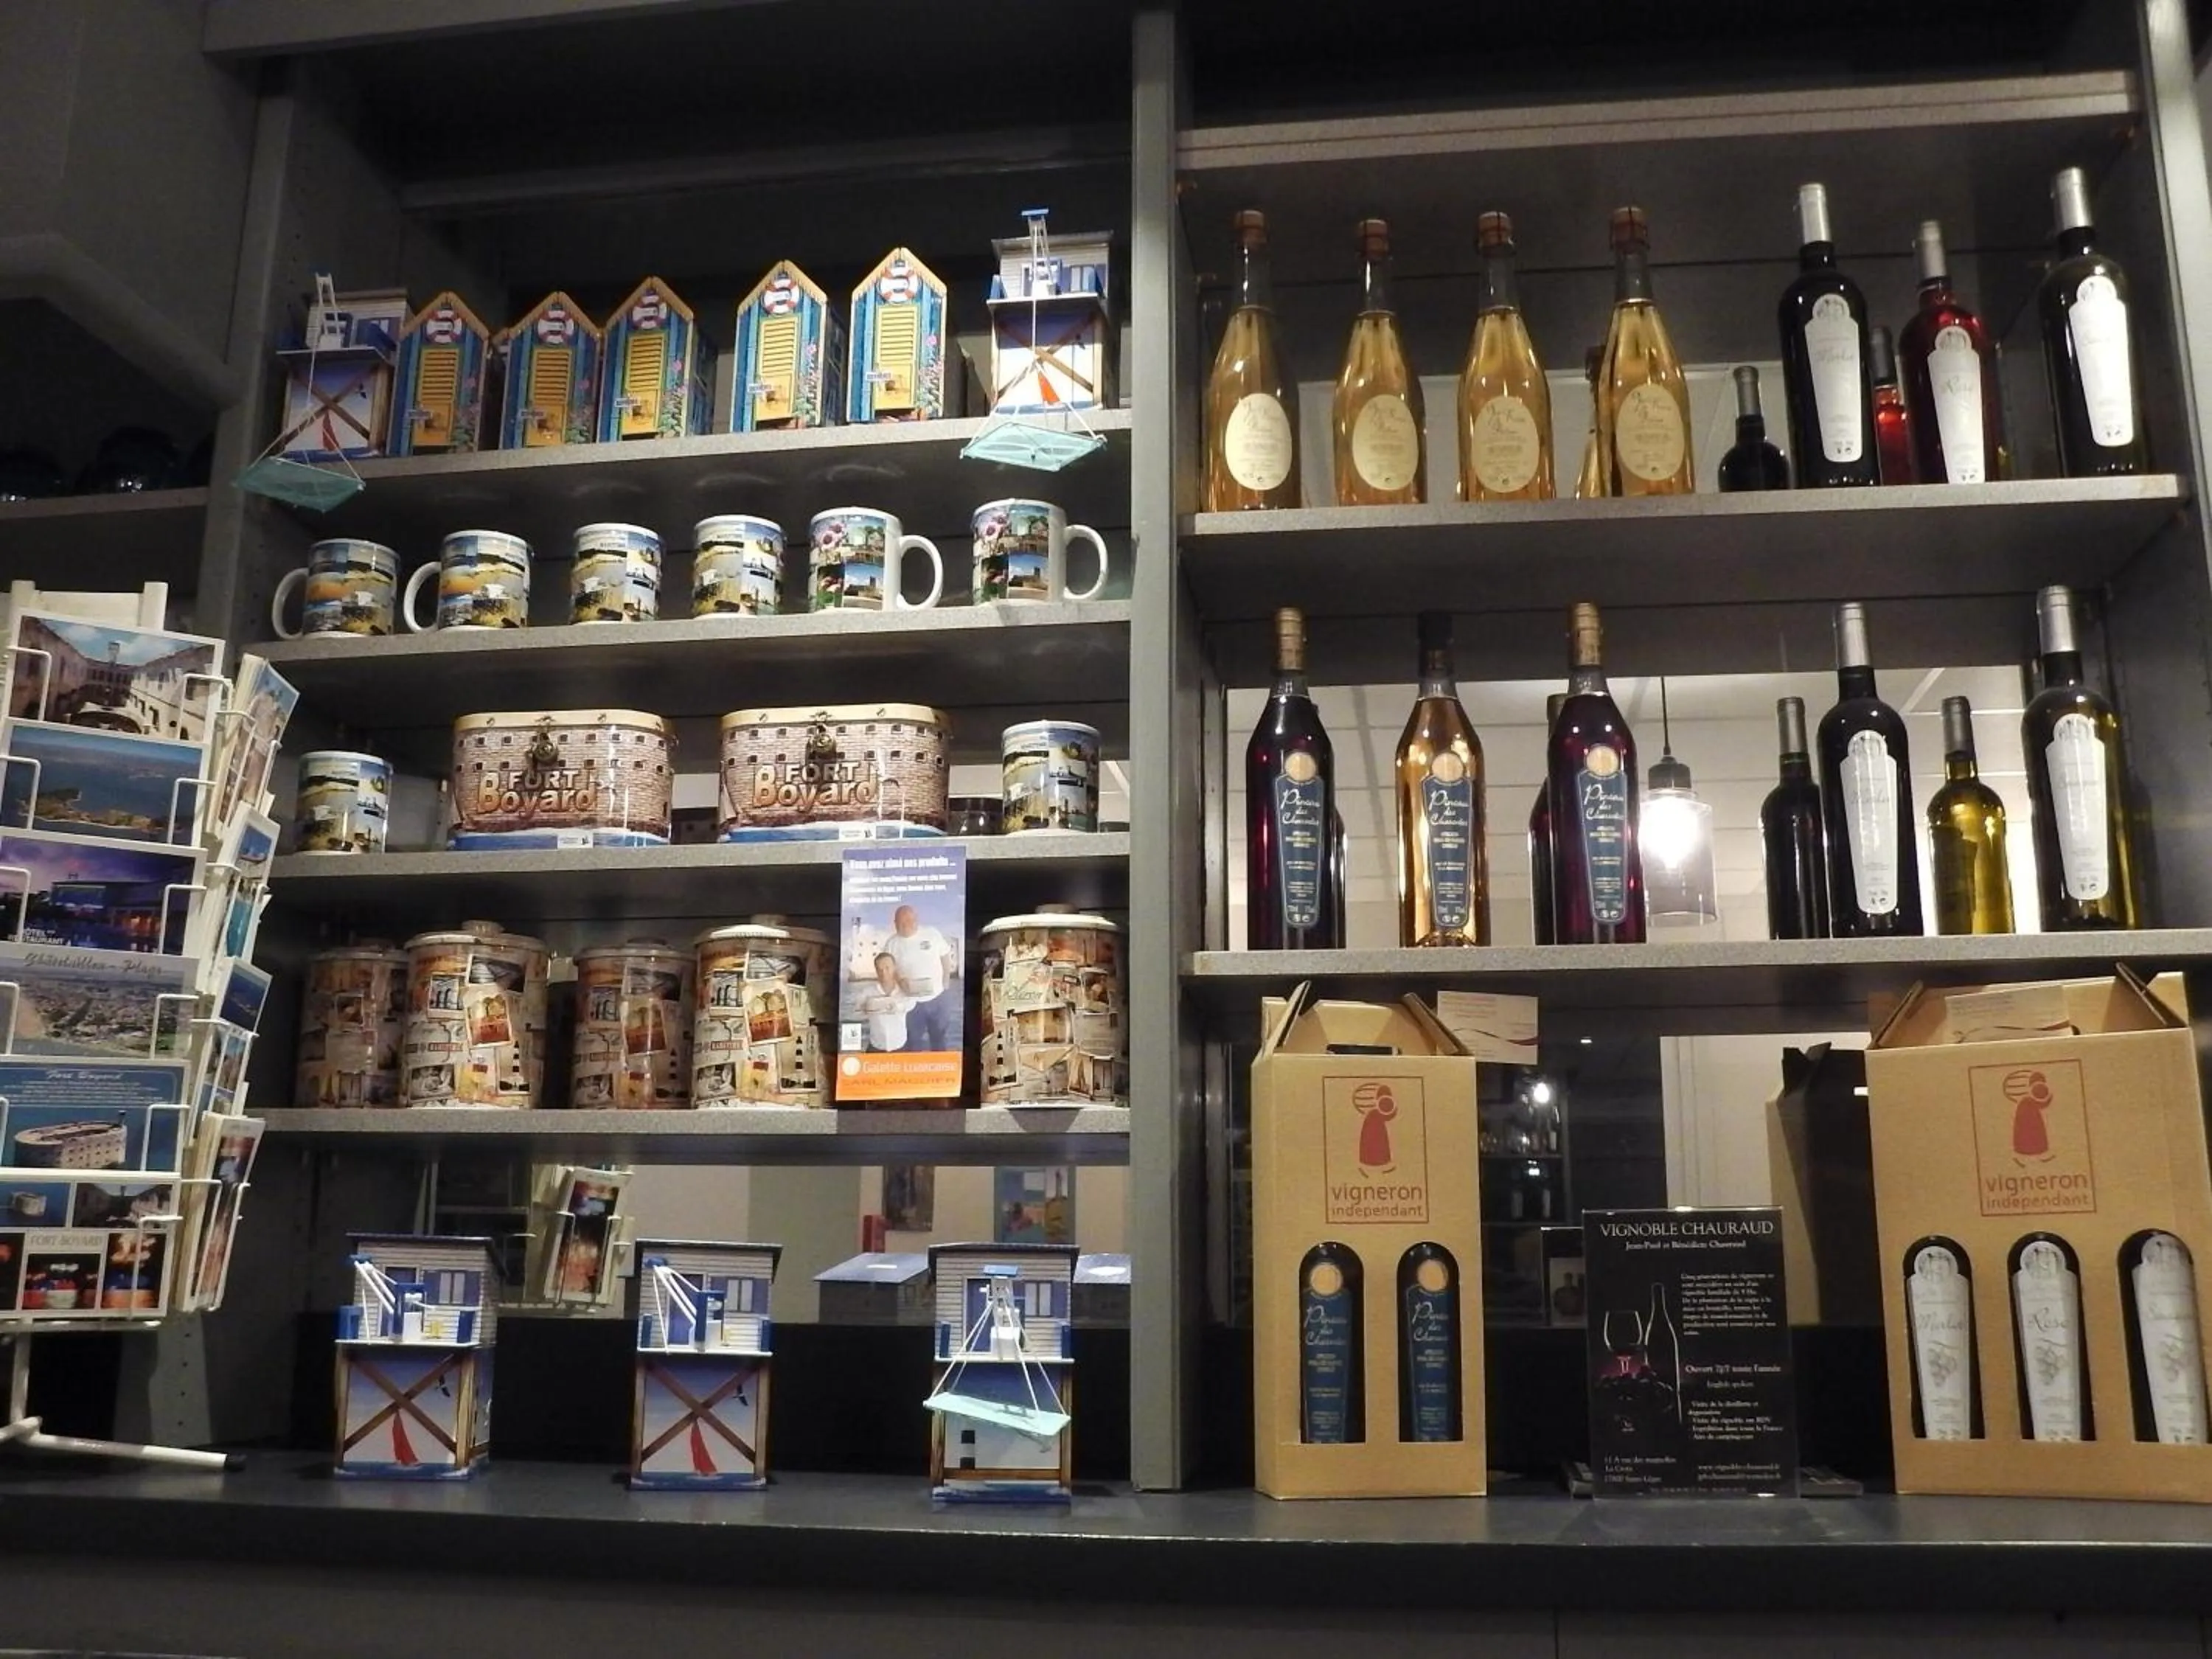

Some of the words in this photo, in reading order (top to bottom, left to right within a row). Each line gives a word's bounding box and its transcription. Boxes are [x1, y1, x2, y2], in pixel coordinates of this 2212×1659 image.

[507, 769, 580, 790] FORT
[785, 762, 859, 782] FORT
[476, 768, 598, 819] Boyard
[752, 762, 877, 813] Boyard
[1332, 1183, 1422, 1205] vigneron
[1985, 1173, 2088, 1196] vigneron
[1600, 1222, 1678, 1237] VIGNOBLE
[1681, 1220, 1774, 1236] CHAURAUD
